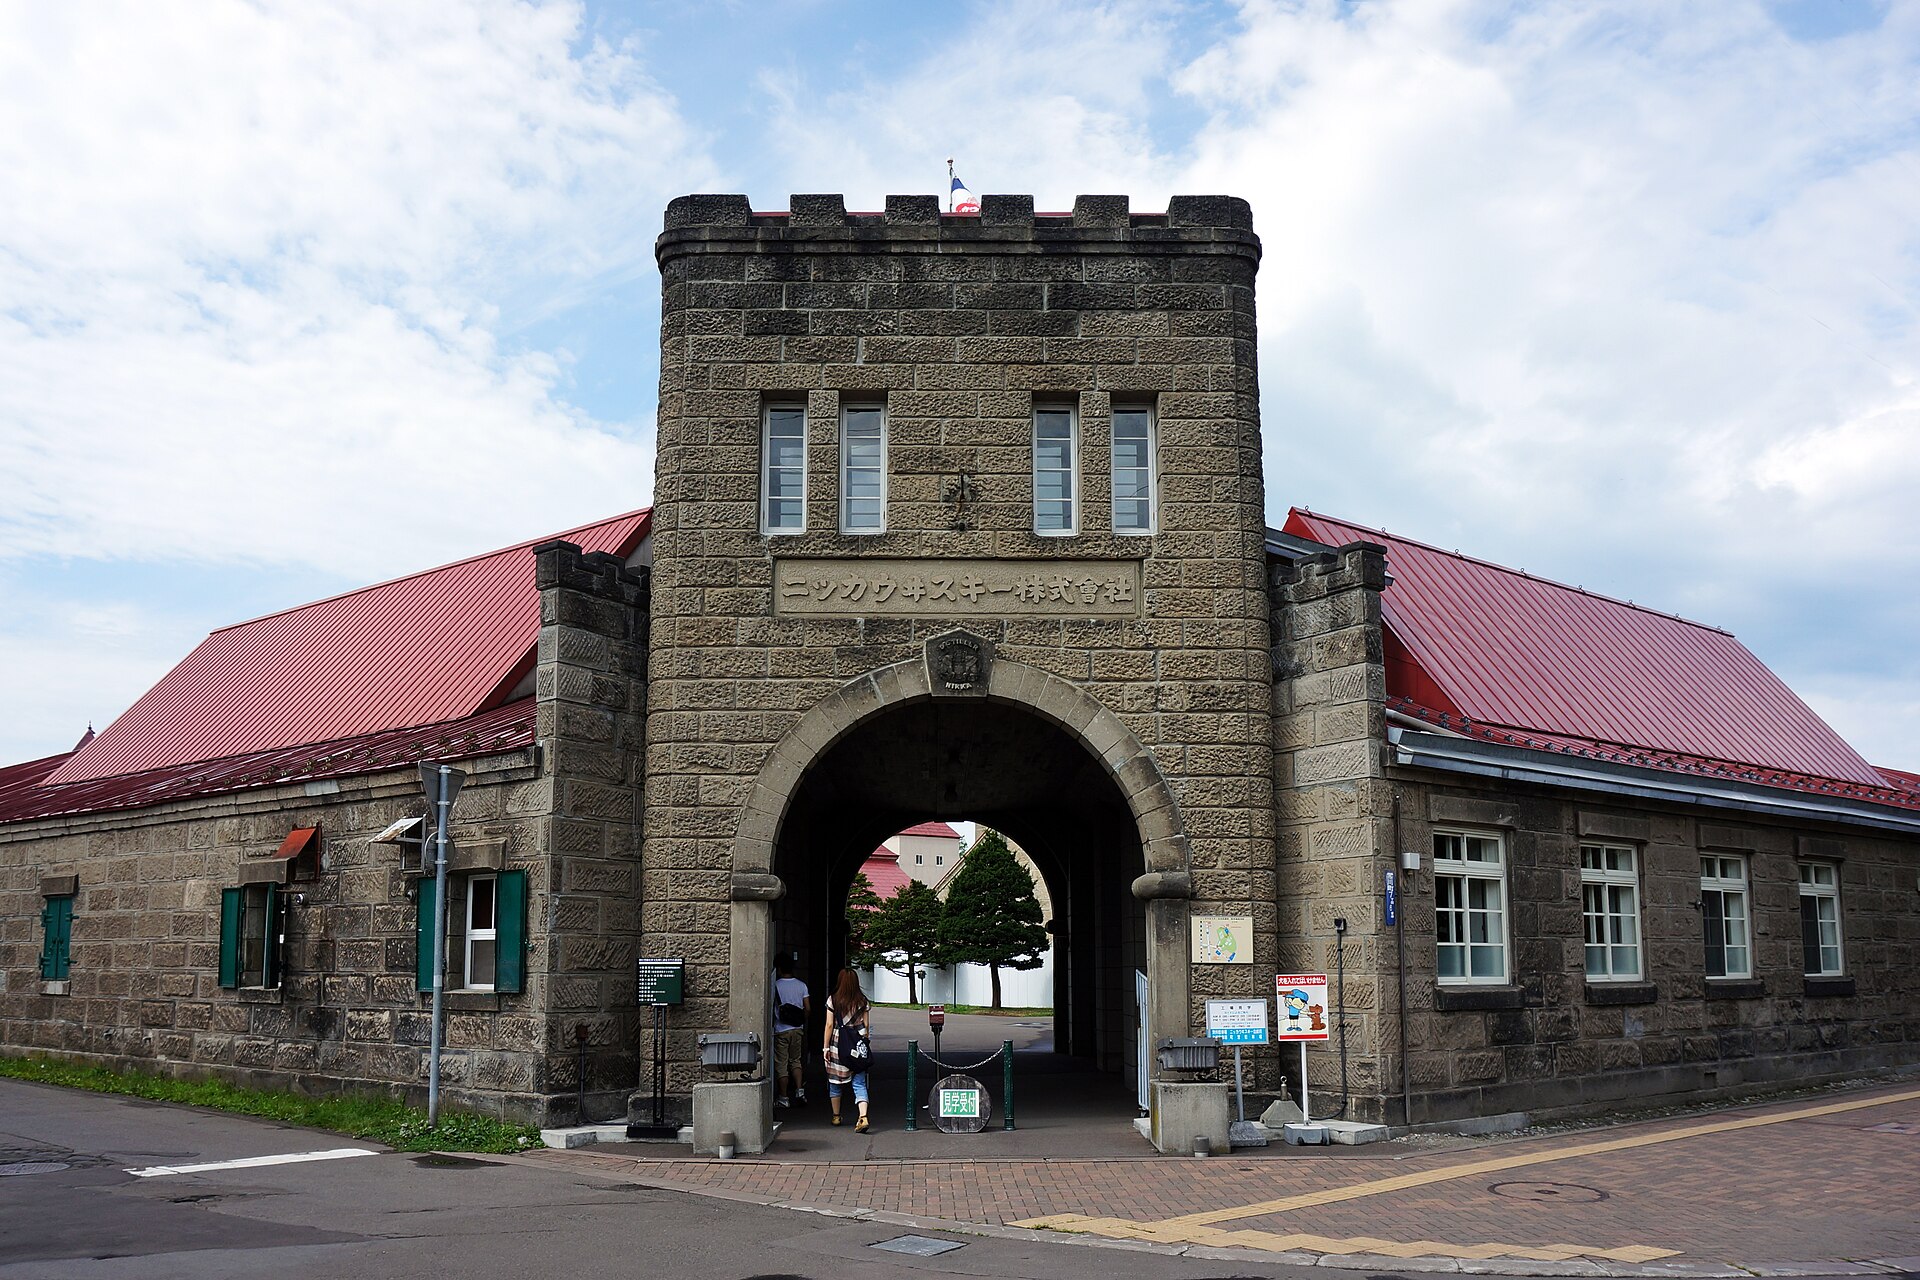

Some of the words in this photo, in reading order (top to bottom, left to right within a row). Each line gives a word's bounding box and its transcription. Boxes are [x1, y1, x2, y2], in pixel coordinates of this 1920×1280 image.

[945, 681, 972, 690] NIKKA
[944, 1092, 977, 1113] 見学受付
